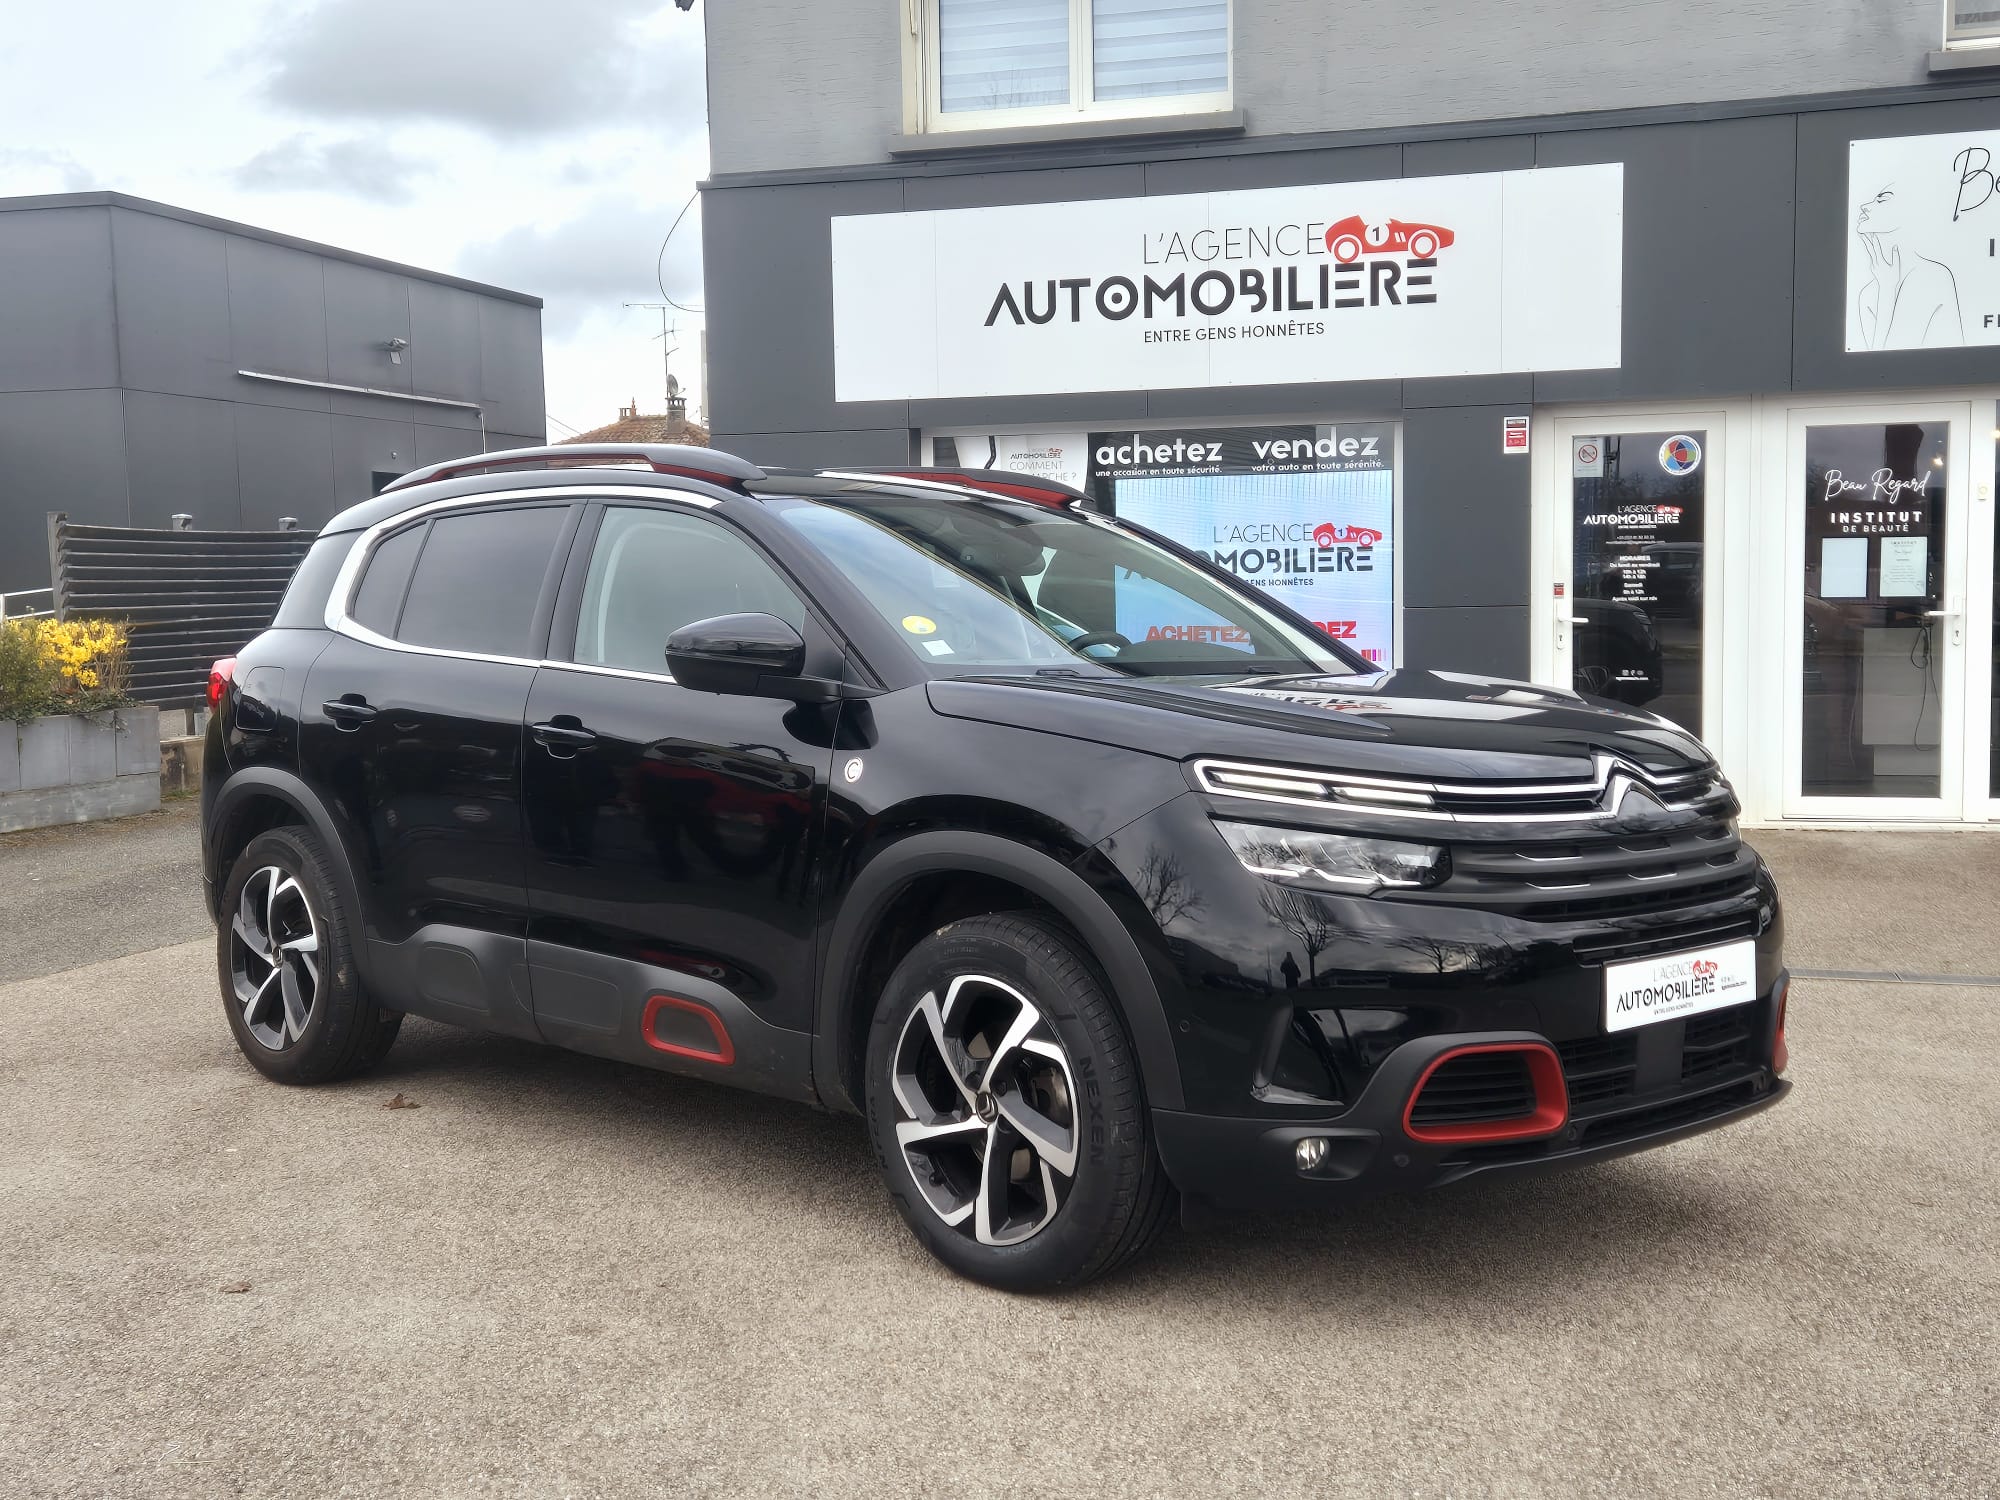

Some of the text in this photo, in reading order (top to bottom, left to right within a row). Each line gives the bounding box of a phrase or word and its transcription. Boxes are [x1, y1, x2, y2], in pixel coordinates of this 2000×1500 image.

[1144, 319, 1325, 344] ENTRE GENS HONNÊTES
[1095, 433, 1224, 466] achetez
[1252, 426, 1379, 460] vendez
[1009, 461, 1065, 471] COMMENT
[1095, 470, 1111, 478] une
[1112, 467, 1148, 477] occasion
[1162, 466, 1184, 475] toute
[1187, 464, 1223, 475] sécurité.
[1251, 459, 1385, 473] votre auto en toute sérénité.
[1824, 467, 1932, 504] Beau Regard
[1830, 511, 1923, 524] INSTITUT
[1213, 522, 1314, 544] L'AGENCE
[1842, 522, 1910, 533] DE BEAUTÉ
[1268, 577, 1314, 587] HONNÊTES
